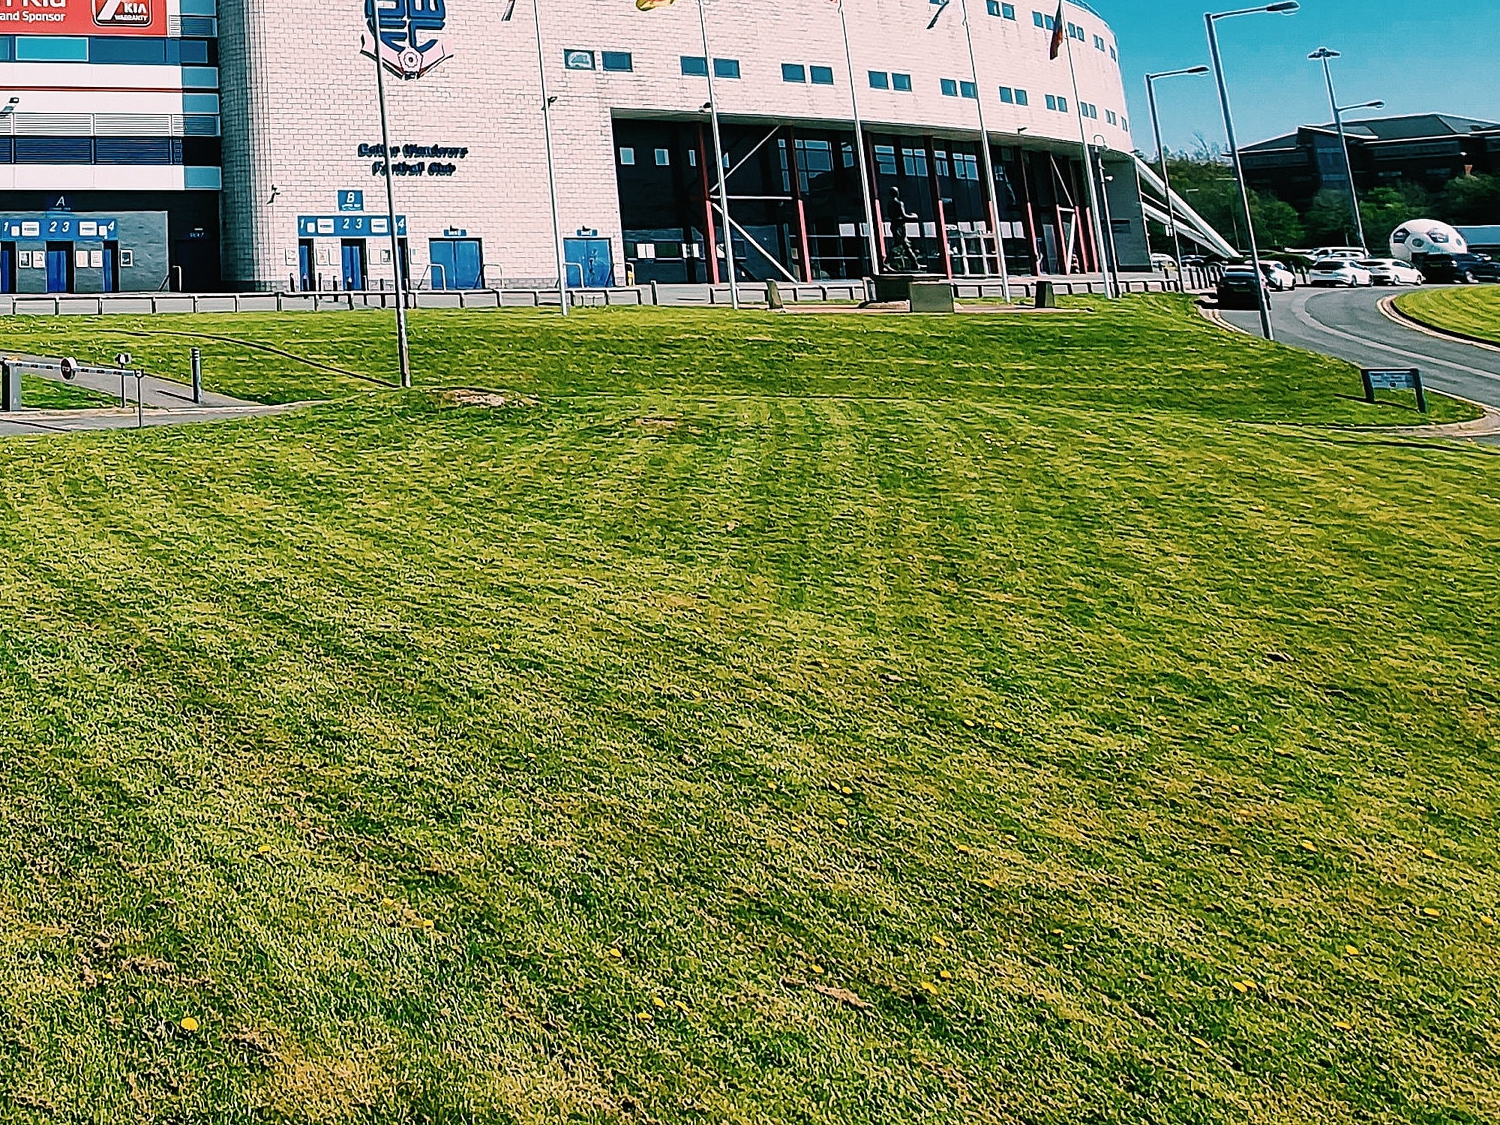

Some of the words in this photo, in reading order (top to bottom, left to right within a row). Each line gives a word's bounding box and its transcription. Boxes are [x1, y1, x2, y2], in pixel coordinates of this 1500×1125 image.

[124, 3, 147, 14] KIA
[21, 11, 66, 24] Sponsor
[56, 196, 66, 207] A
[346, 192, 355, 203] B
[3, 221, 9, 232] 1
[49, 221, 57, 232] 2
[62, 221, 70, 232] 3
[108, 221, 115, 232] 4
[343, 218, 350, 229] 2
[355, 218, 362, 229] 3
[398, 218, 405, 229] 4
